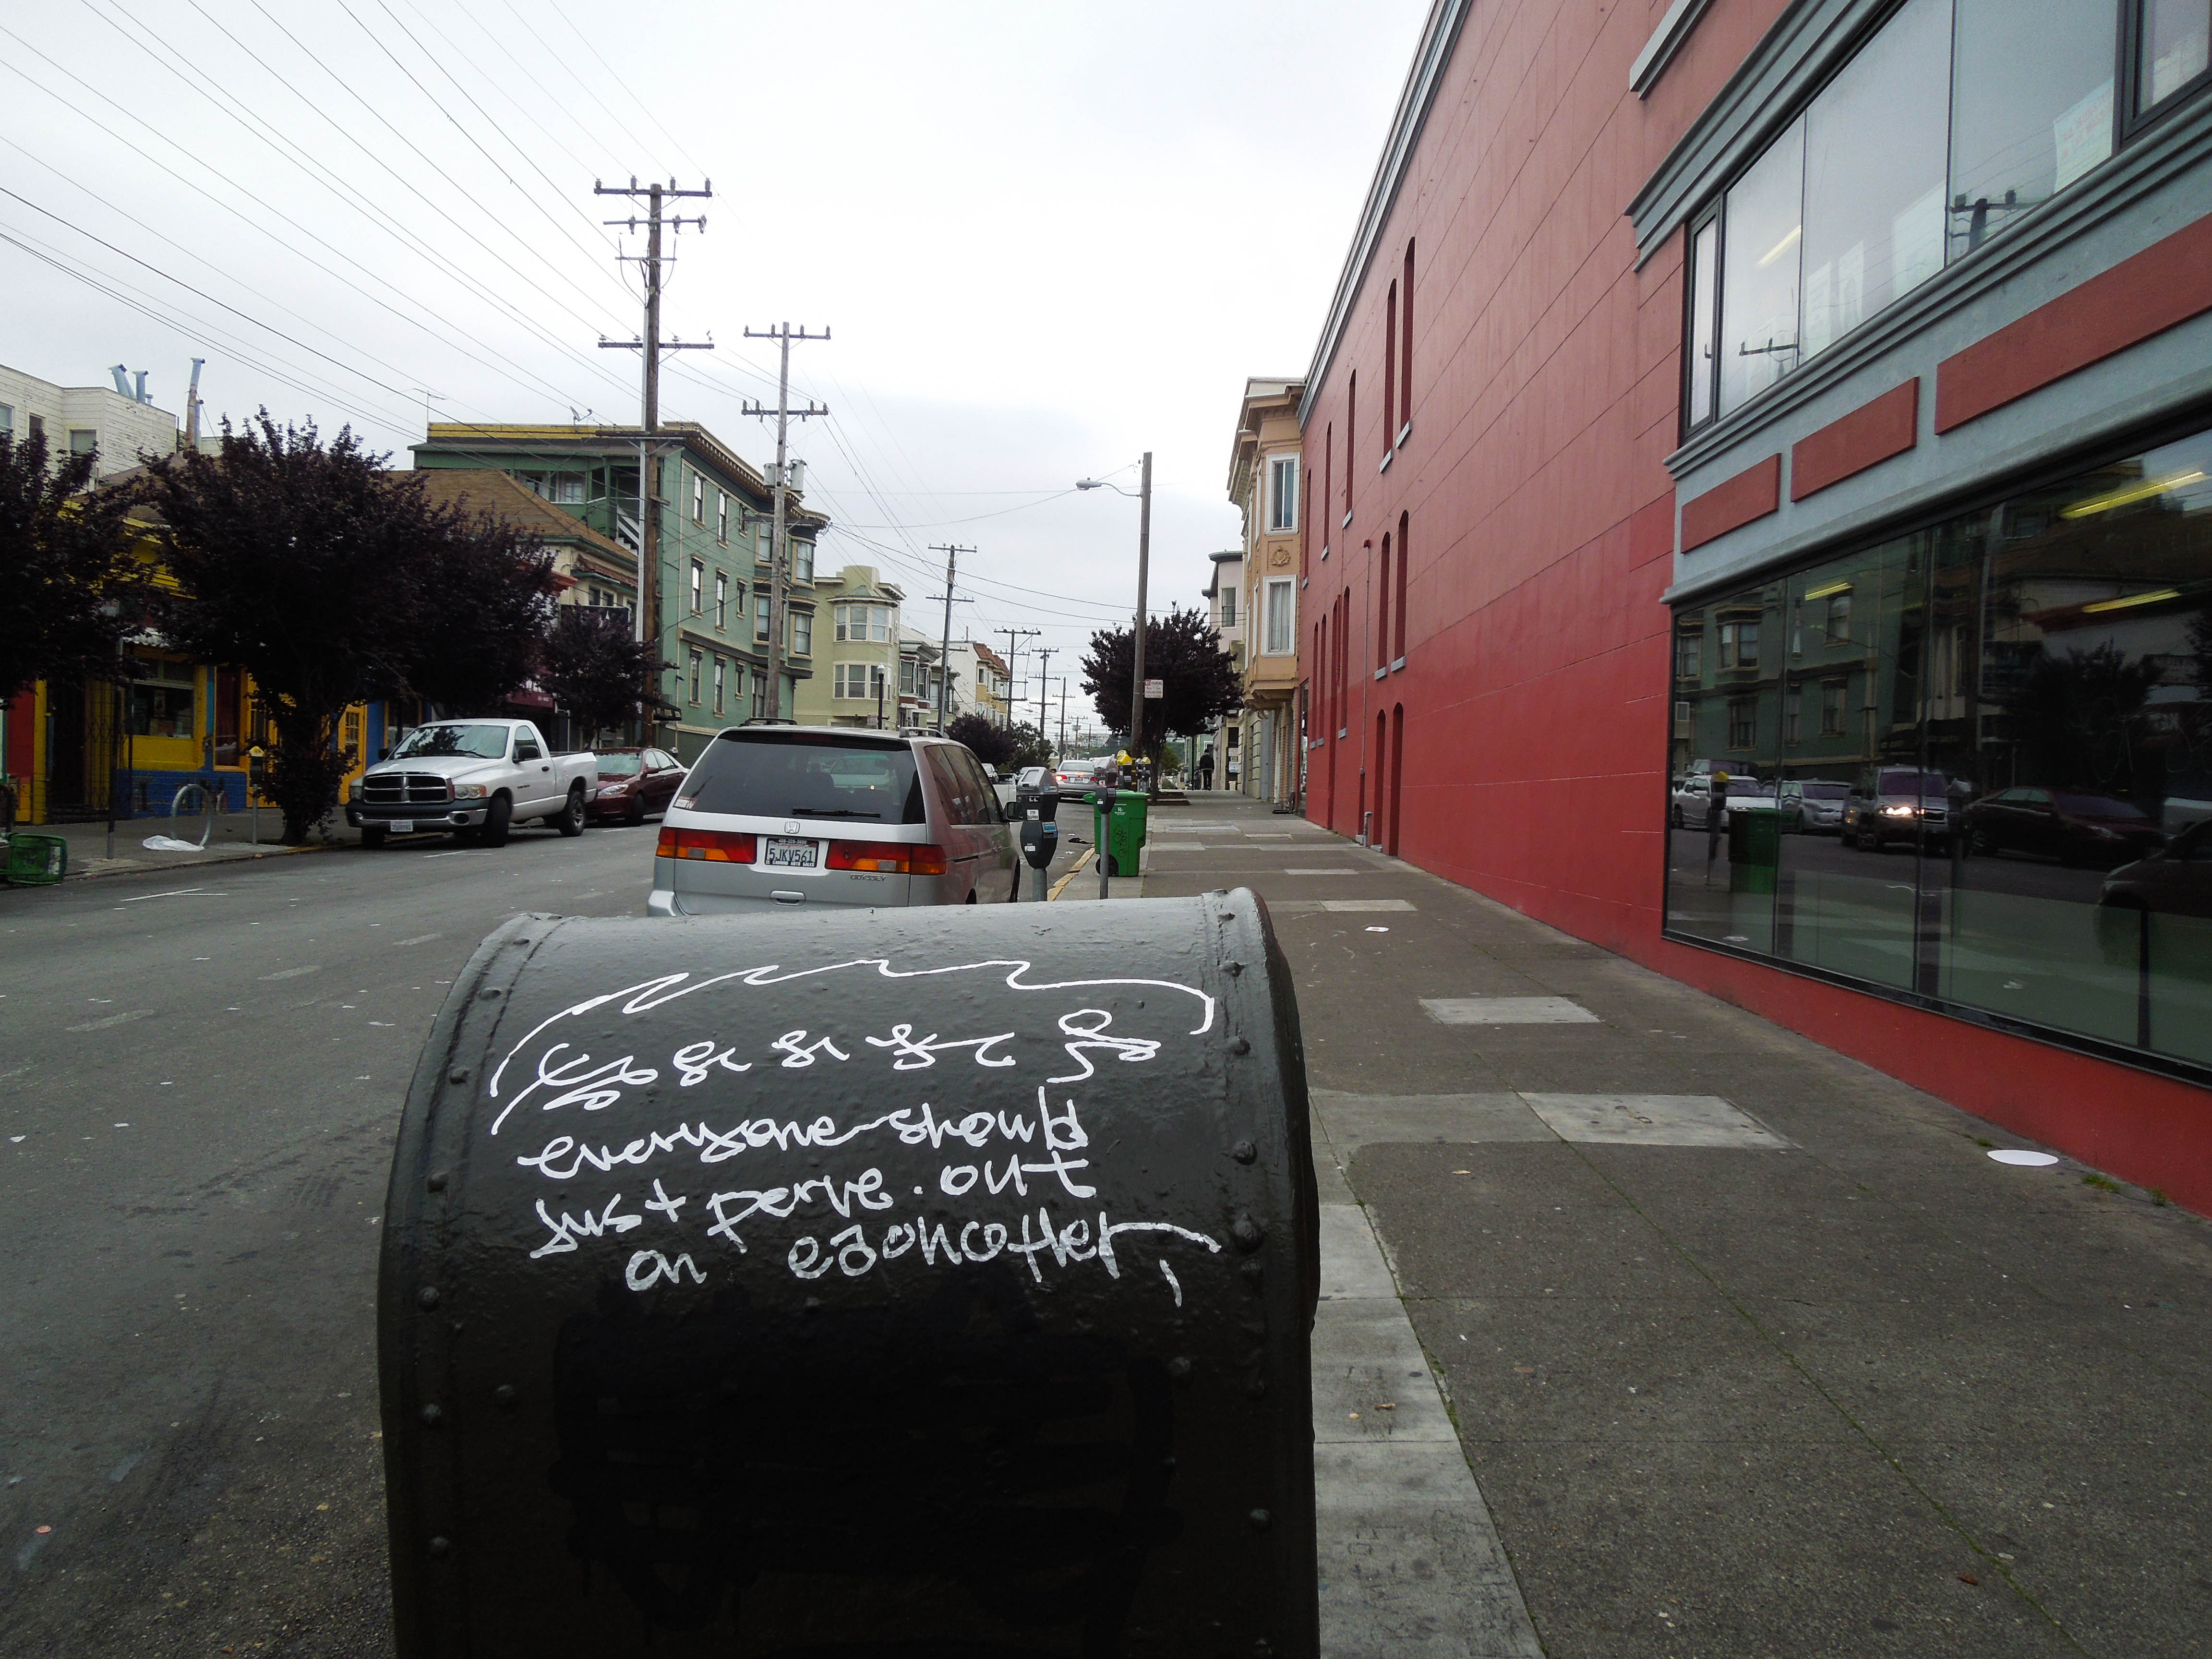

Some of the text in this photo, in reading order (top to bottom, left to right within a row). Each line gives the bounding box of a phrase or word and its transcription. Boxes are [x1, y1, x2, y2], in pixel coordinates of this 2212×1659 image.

[769, 848, 812, 863] 5JKV561
[888, 1086, 1089, 1150] should
[940, 1152, 1097, 1199] out
[625, 1250, 707, 1291] on
